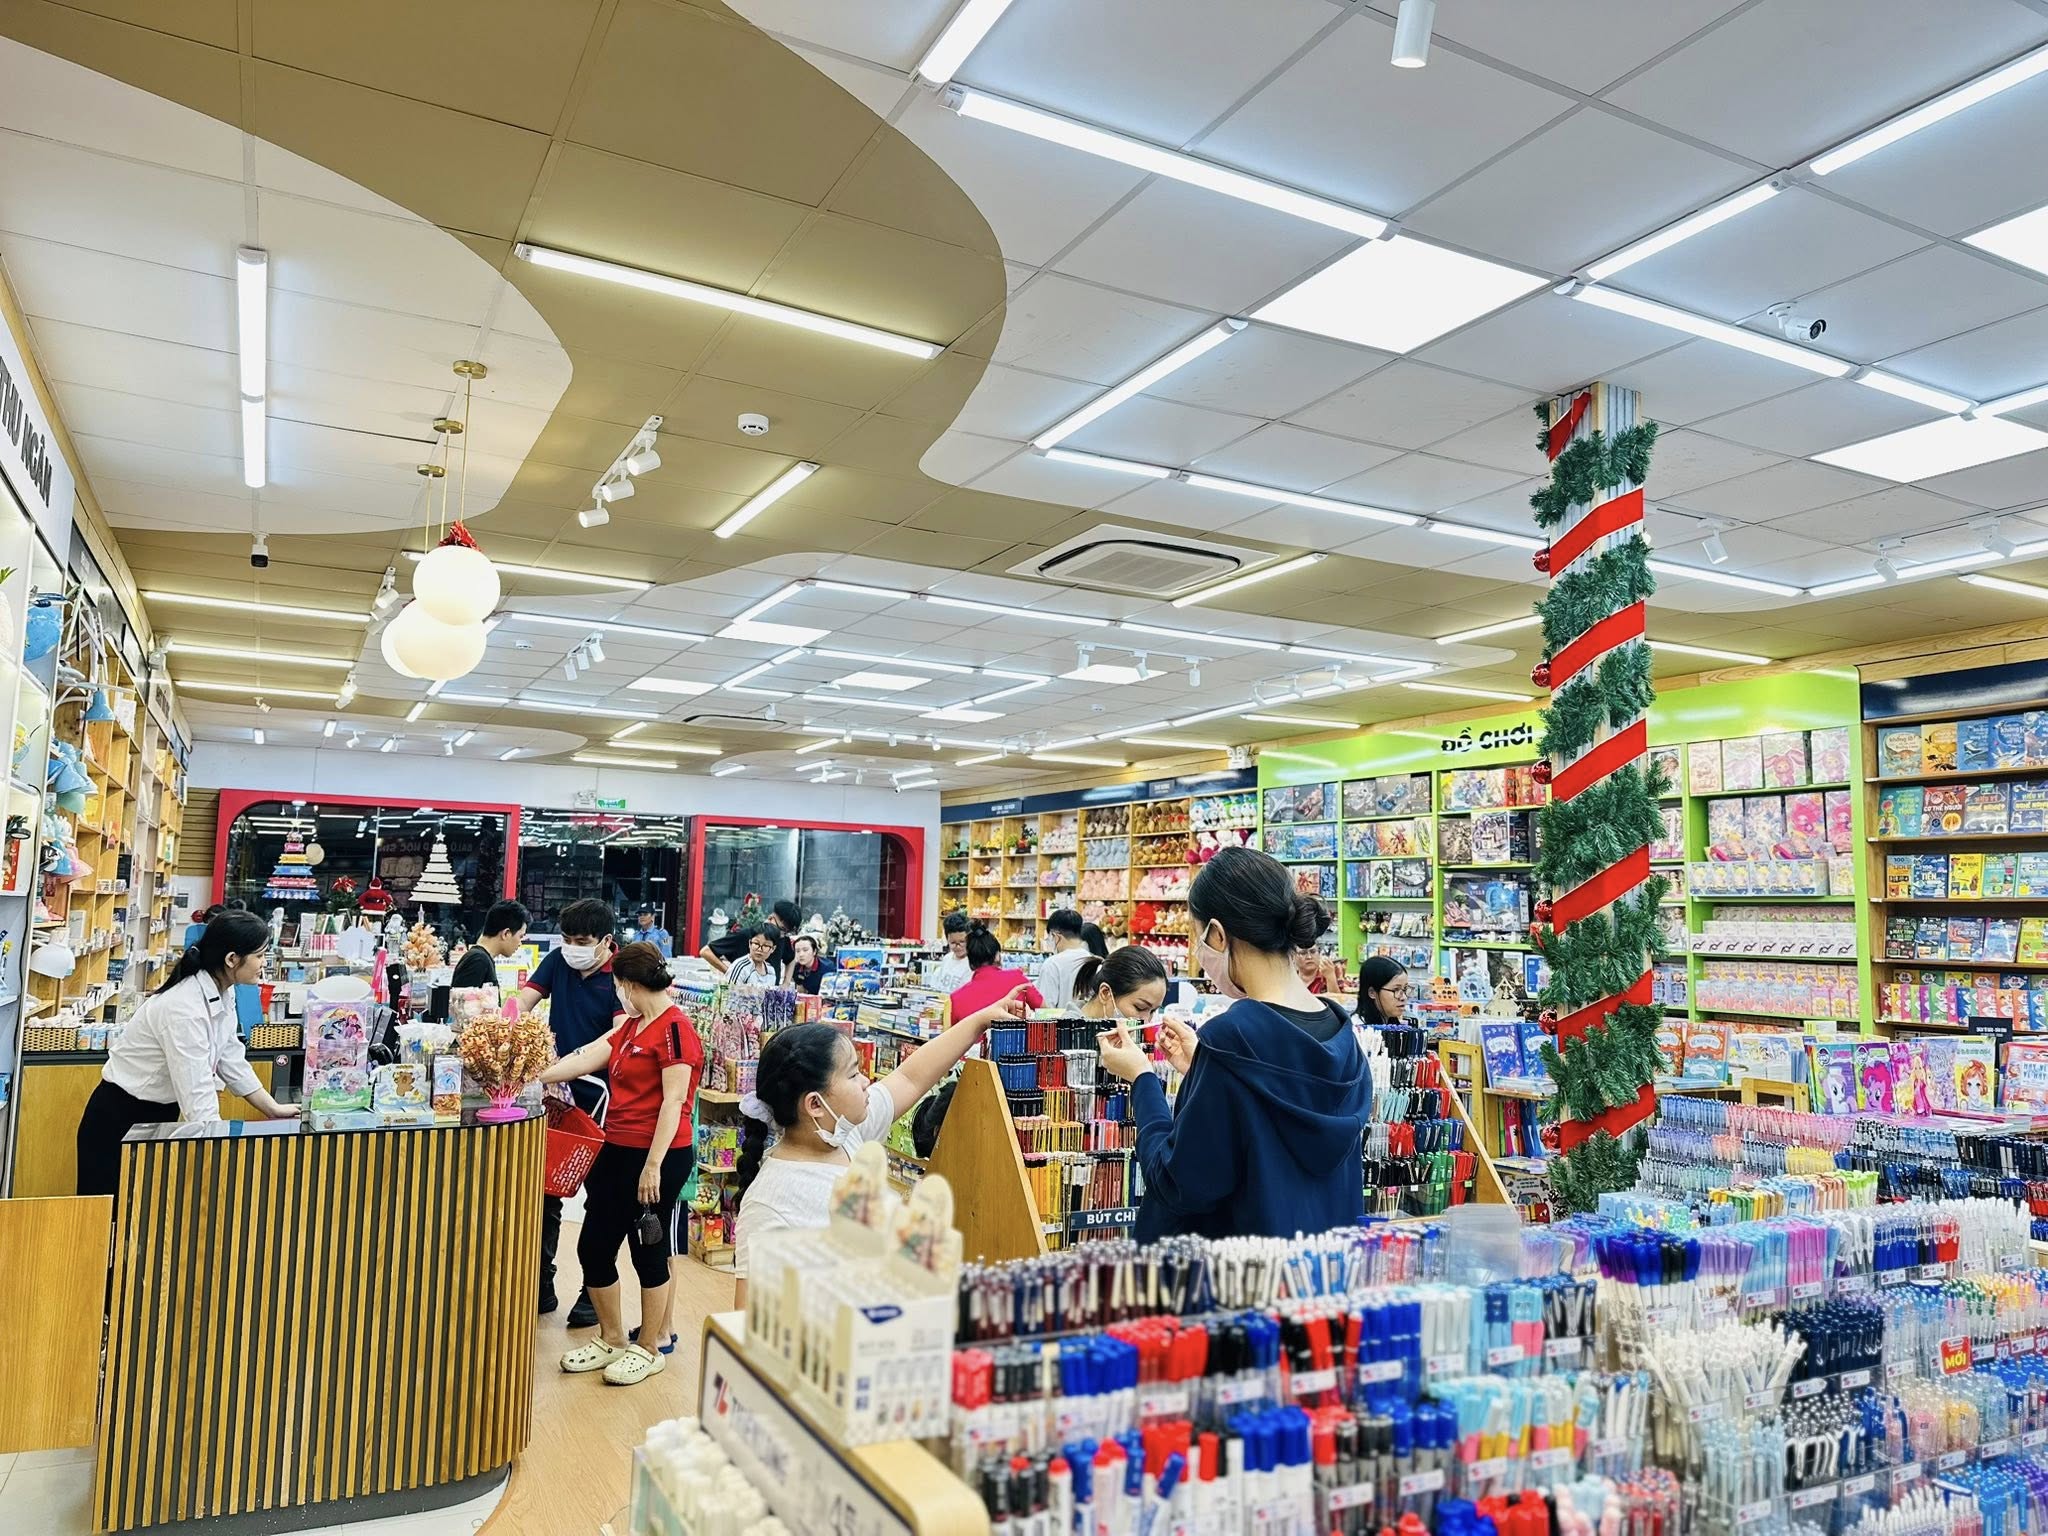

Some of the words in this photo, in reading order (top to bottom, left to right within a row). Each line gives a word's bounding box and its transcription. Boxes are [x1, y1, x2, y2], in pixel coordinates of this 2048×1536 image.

[21, 413, 52, 508] NGÂN
[1441, 727, 1472, 753] ĐỒ
[1479, 722, 1533, 749] CHƠI
[1086, 1210, 1112, 1225] BÚT
[1114, 1208, 1136, 1223] CHÌ
[1945, 1351, 1967, 1368] MỚI
